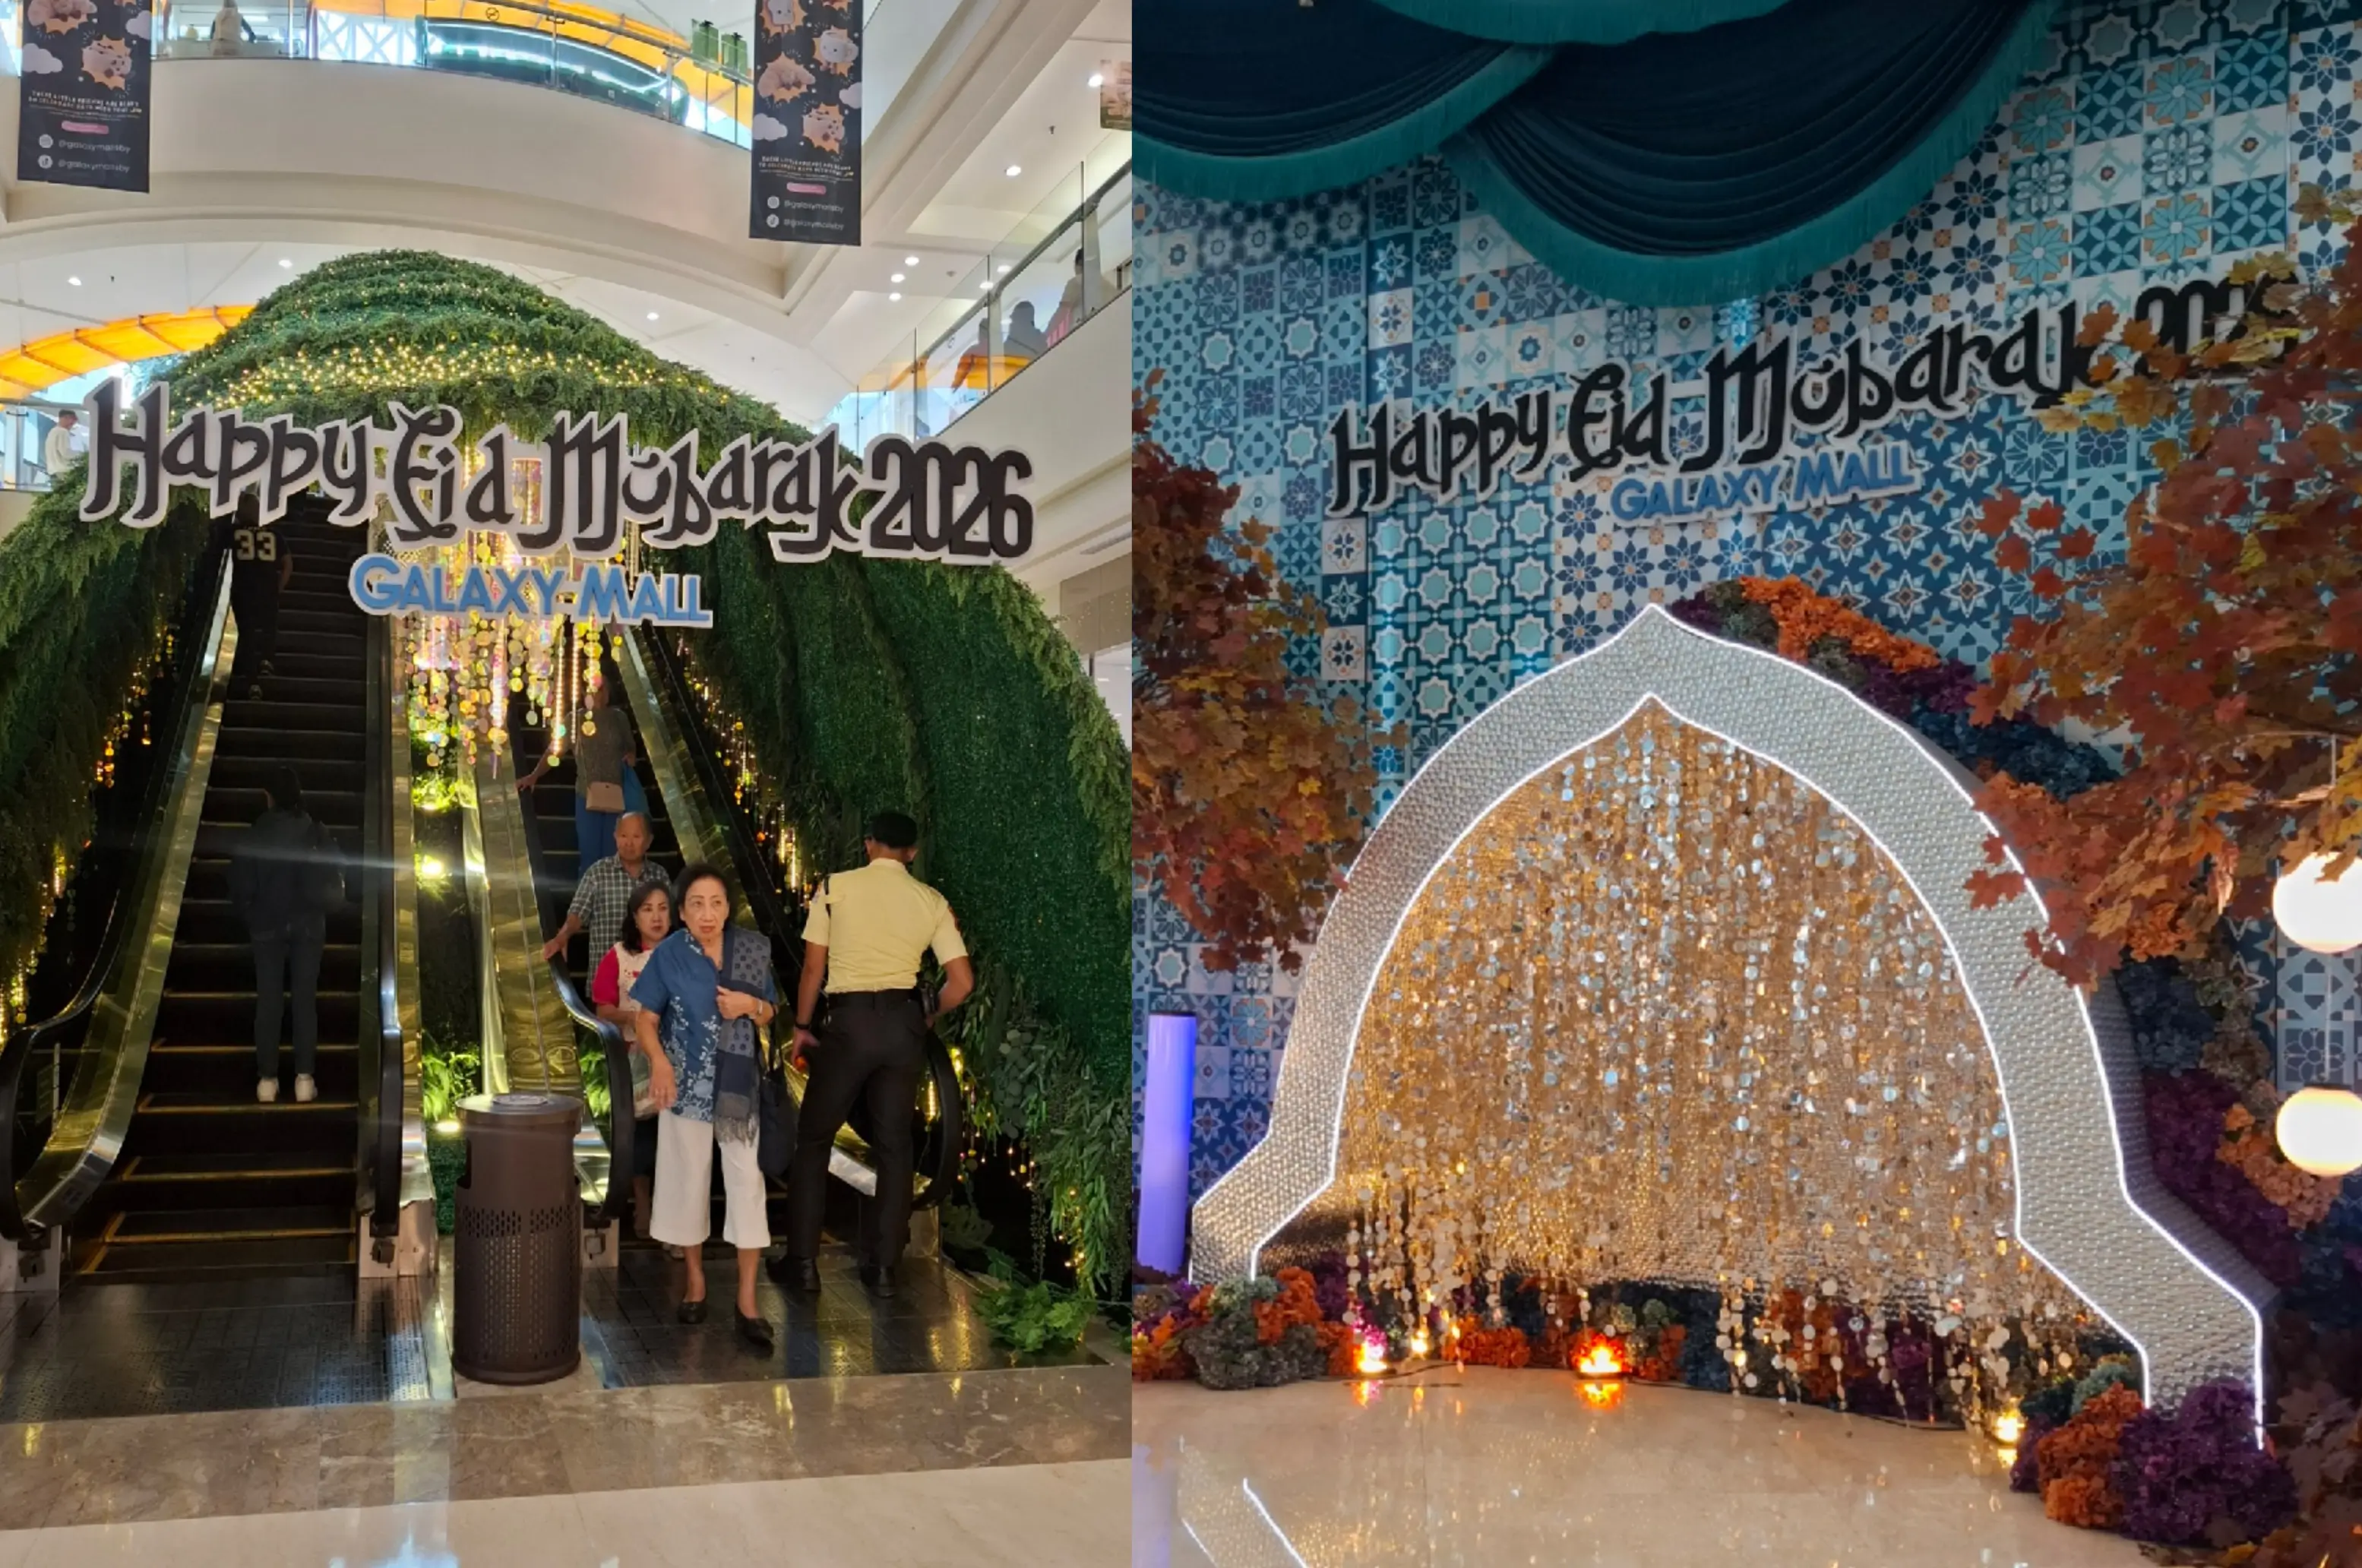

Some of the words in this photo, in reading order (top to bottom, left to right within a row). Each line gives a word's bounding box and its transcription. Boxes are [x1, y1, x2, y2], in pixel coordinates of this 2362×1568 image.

[84, 380, 367, 520] Happy
[392, 406, 514, 541] Eid
[518, 417, 862, 554] Mubarak
[870, 438, 1033, 558] 2026
[1328, 390, 1550, 512] Happy
[1569, 362, 1669, 482] Eid
[1610, 463, 1781, 520] GALAXY
[1794, 444, 1915, 502] MALL
[234, 530, 277, 561] 33
[354, 556, 564, 616] GALAXY
[578, 566, 711, 622] MALL
